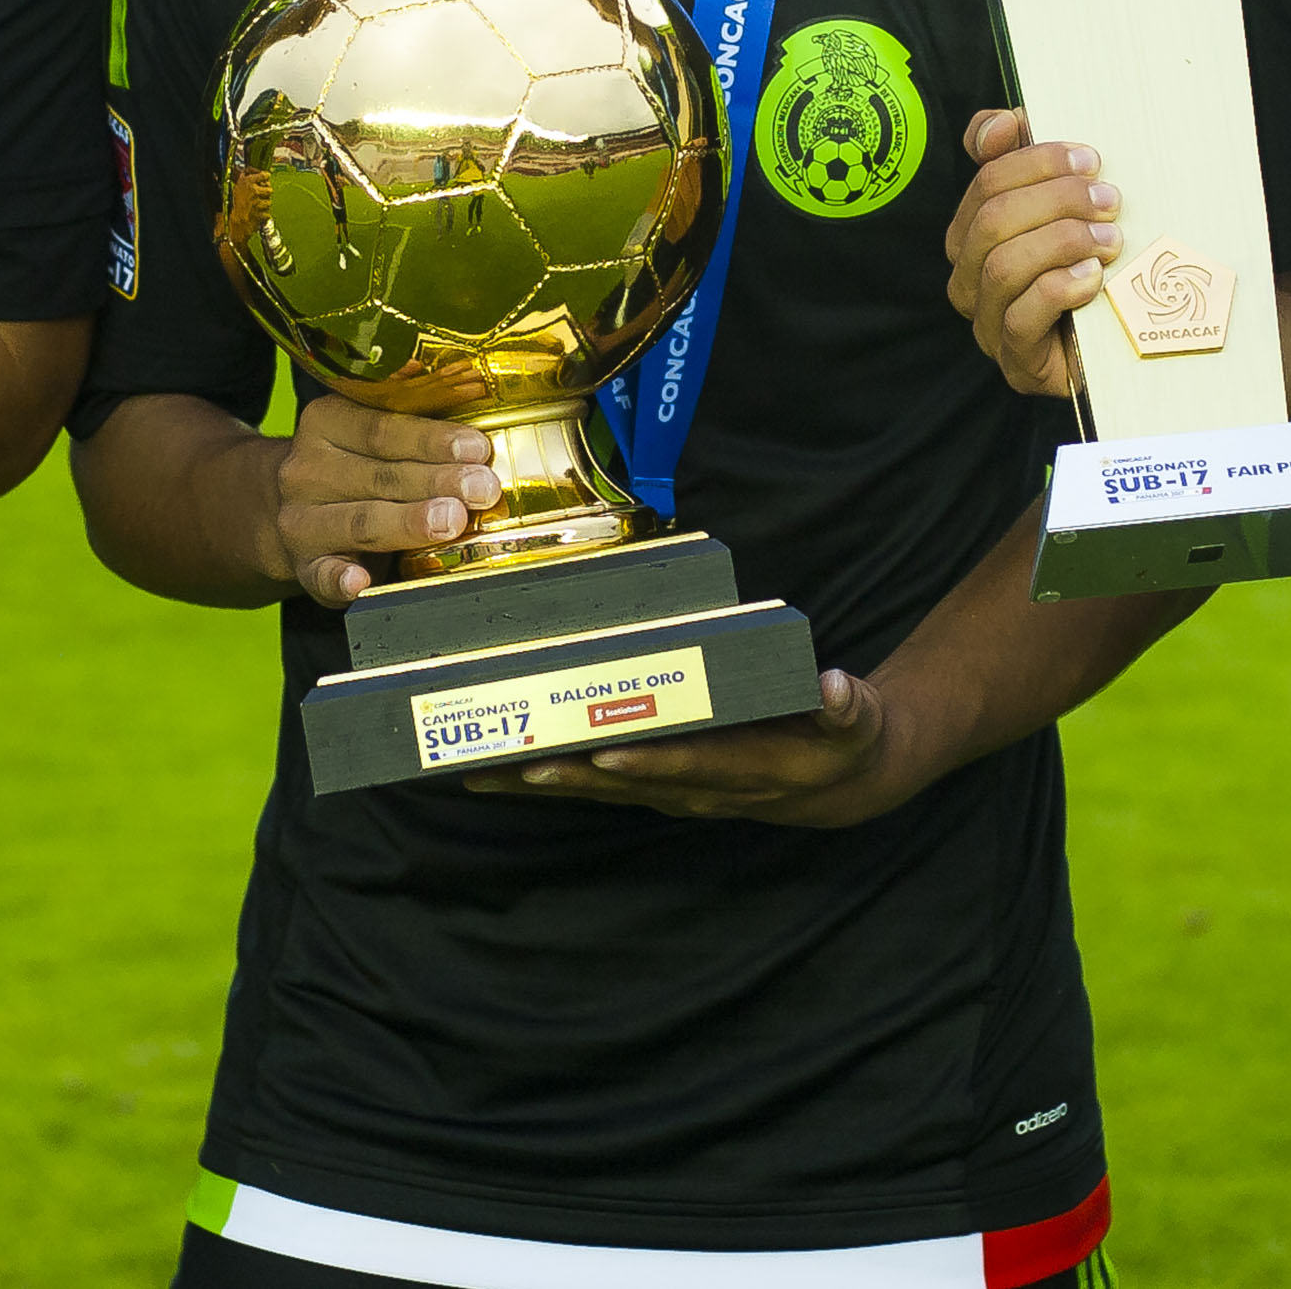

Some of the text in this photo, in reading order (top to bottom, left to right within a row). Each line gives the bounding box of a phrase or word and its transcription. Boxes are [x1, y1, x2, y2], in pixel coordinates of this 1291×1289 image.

[1138, 325, 1222, 344] CONCACAF
[658, 288, 698, 424] CONCAC
[1101, 459, 1207, 477] CAMPEONATO
[1226, 463, 1273, 479] FAIR
[1104, 469, 1209, 495] SUB-17
[550, 670, 686, 705] BALÓN DE ORO
[422, 700, 530, 726] CAMPEONATO
[425, 713, 531, 750] SUB-17
